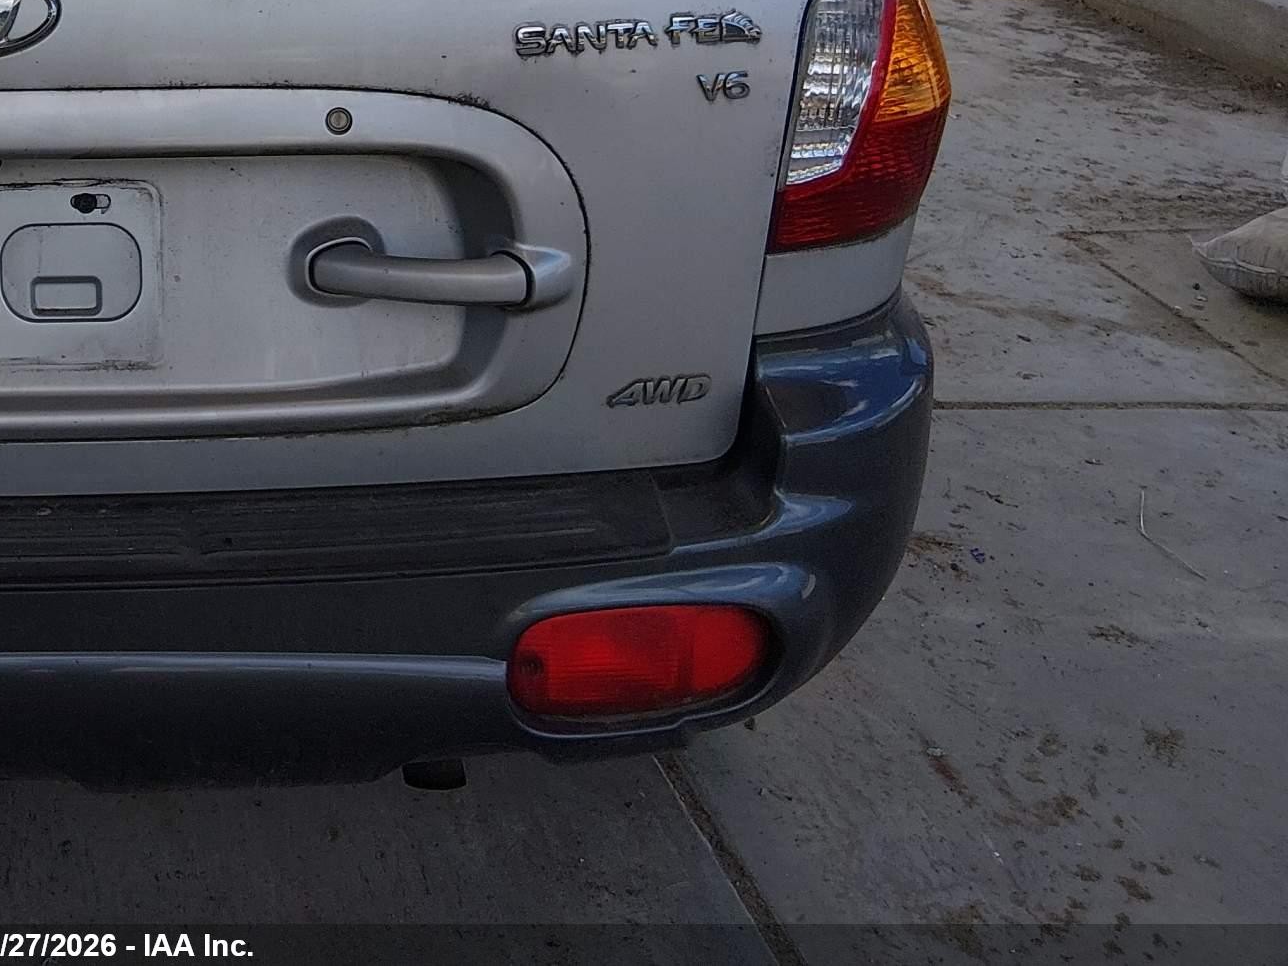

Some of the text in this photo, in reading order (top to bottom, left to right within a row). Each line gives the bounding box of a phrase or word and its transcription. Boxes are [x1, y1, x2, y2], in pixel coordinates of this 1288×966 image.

[515, 18, 659, 57] SANTA
[696, 71, 751, 102] V6
[607, 373, 711, 408] 4WD
